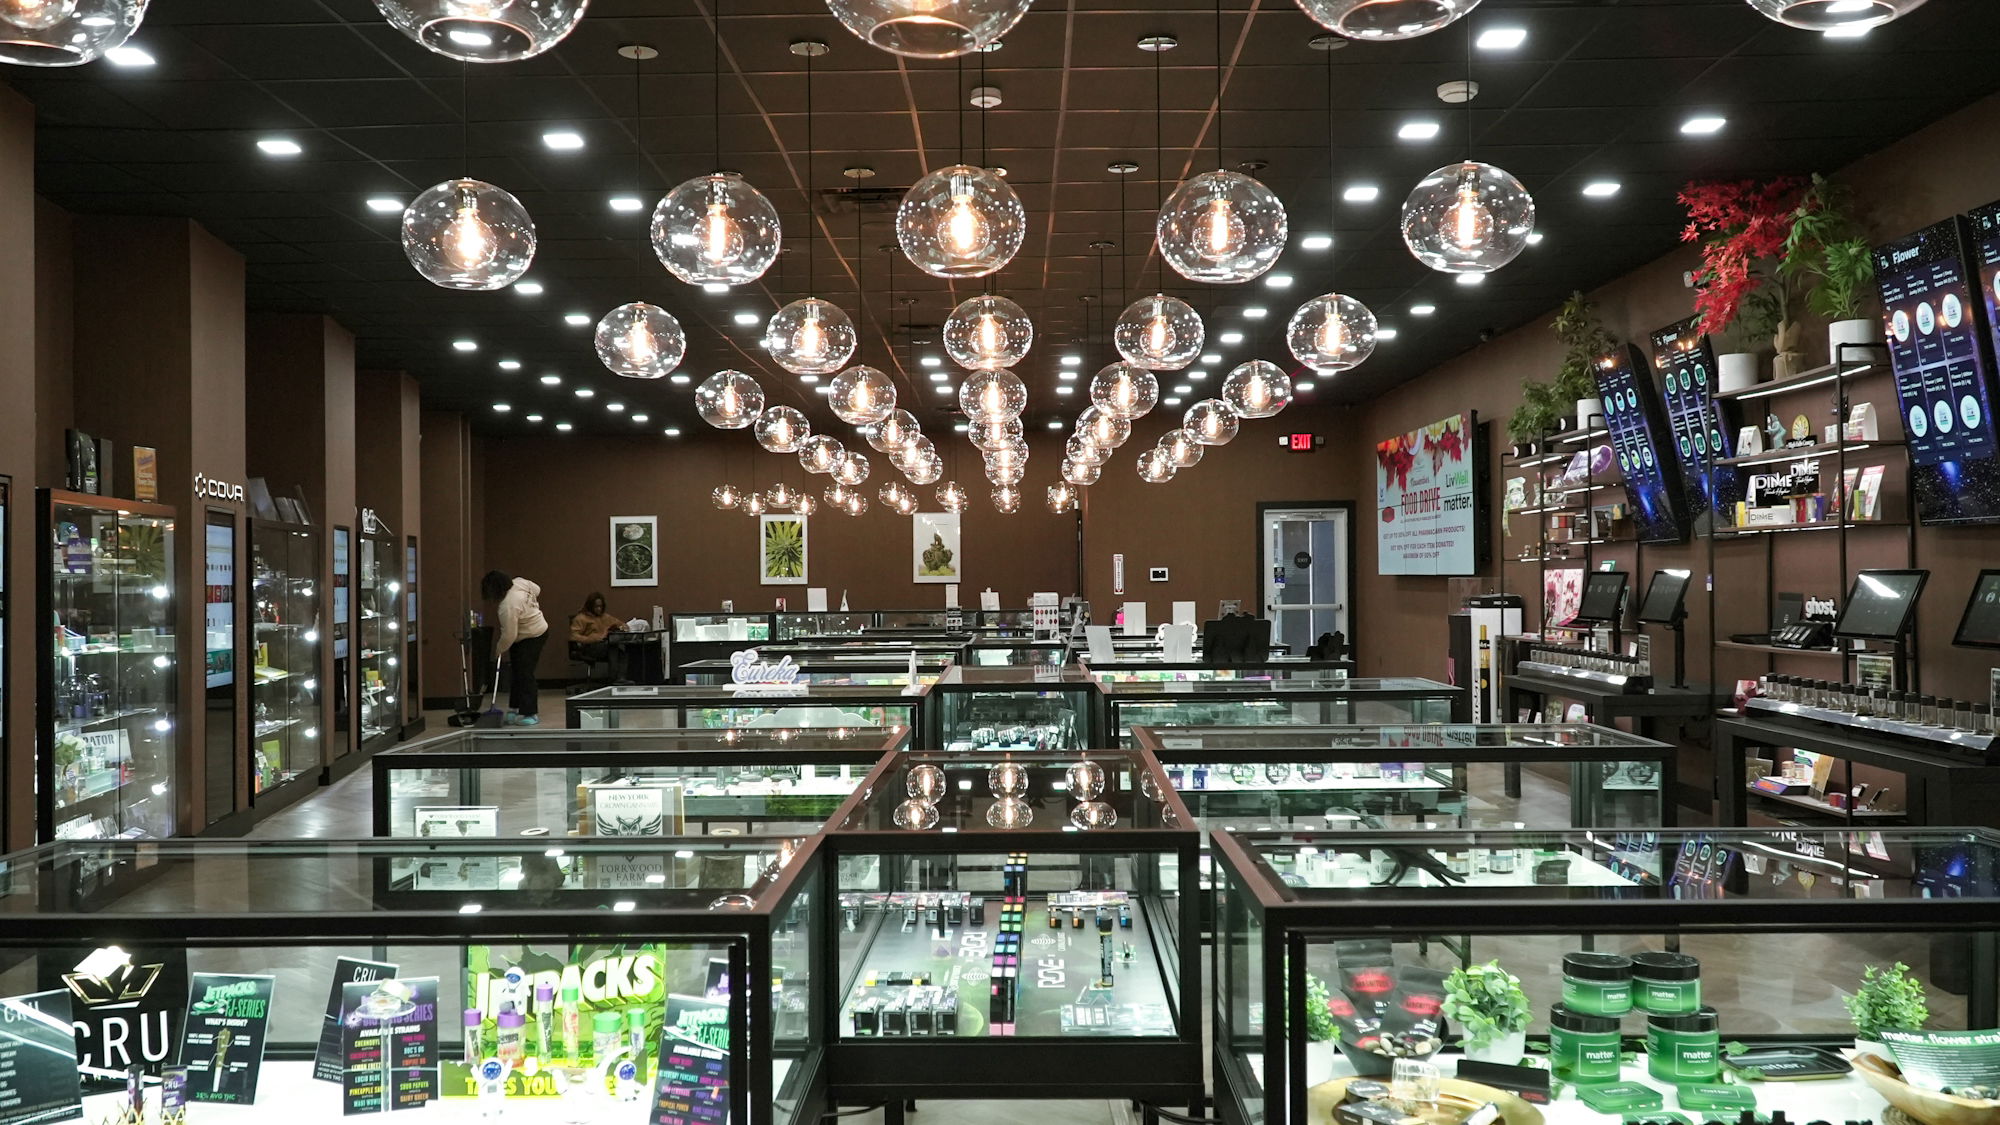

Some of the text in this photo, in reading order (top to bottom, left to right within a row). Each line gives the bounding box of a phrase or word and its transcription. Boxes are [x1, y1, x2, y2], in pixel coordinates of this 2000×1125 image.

[1892, 245, 1920, 264] Flower
[1291, 434, 1312, 450] EXIT
[1790, 457, 1819, 477] DIME
[1446, 470, 1468, 488] LivWell
[1756, 472, 1792, 490] DIME
[208, 479, 244, 502] COVA
[1401, 487, 1440, 516] FOOD DRIVE
[1444, 494, 1472, 512] matter.
[731, 650, 798, 682] Eureka
[601, 864, 662, 873] TORRWOOD
[616, 873, 646, 882] FARM
[353, 966, 377, 982] CRU
[203, 980, 256, 1002] JETPACKS
[1606, 992, 1628, 1000] matter.
[1651, 991, 1676, 999] matter.
[205, 1018, 248, 1027] WHAT'S INSIDE?
[394, 1024, 420, 1035] STRAINS
[72, 1010, 169, 1071] CRU
[698, 1026, 730, 1050] FJ-SERIE
[1881, 1032, 1929, 1044] matter.
[1928, 1034, 1972, 1044] flower
[1586, 1051, 1615, 1059] matter.
[1682, 1051, 1712, 1059] matter.
[164, 1080, 179, 1089] CRU
[349, 1087, 374, 1096] PINEAPPLE
